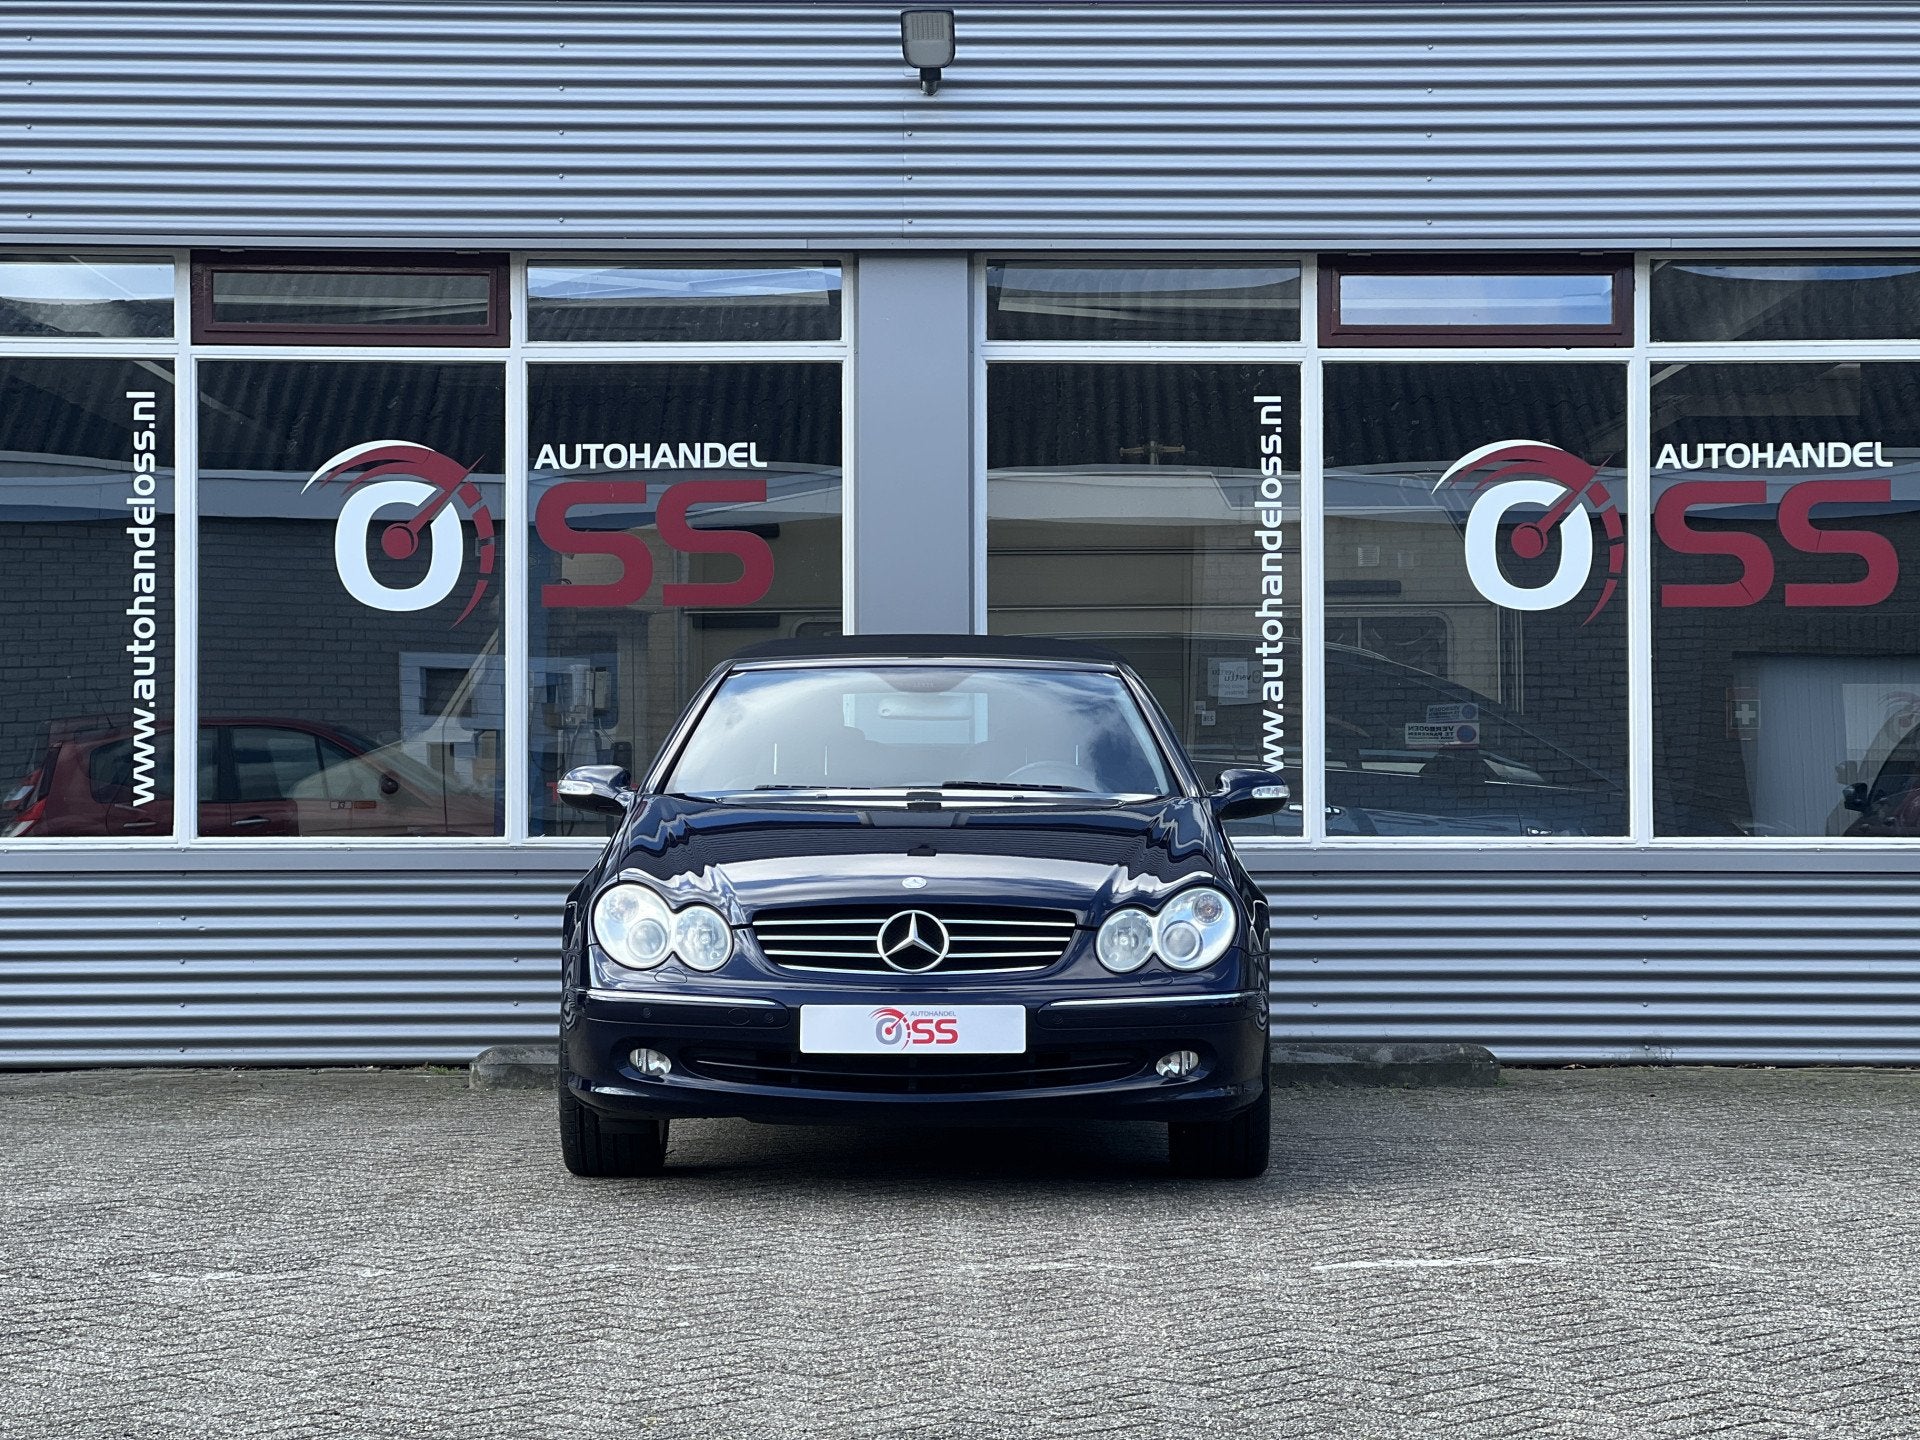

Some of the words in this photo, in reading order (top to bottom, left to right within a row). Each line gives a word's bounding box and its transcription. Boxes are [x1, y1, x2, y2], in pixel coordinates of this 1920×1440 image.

[533, 441, 769, 470] AUTOHANDEL
[1655, 441, 1894, 470] AUTOHANDEL
[334, 479, 775, 612] OSS
[1253, 395, 1285, 773] ww.autohandeloss.nl
[1464, 479, 1900, 611] OSS
[126, 390, 156, 807] www.autohandeloss.nl
[875, 1017, 959, 1046] OSS
[909, 1010, 957, 1018] AUTOHANDEL
